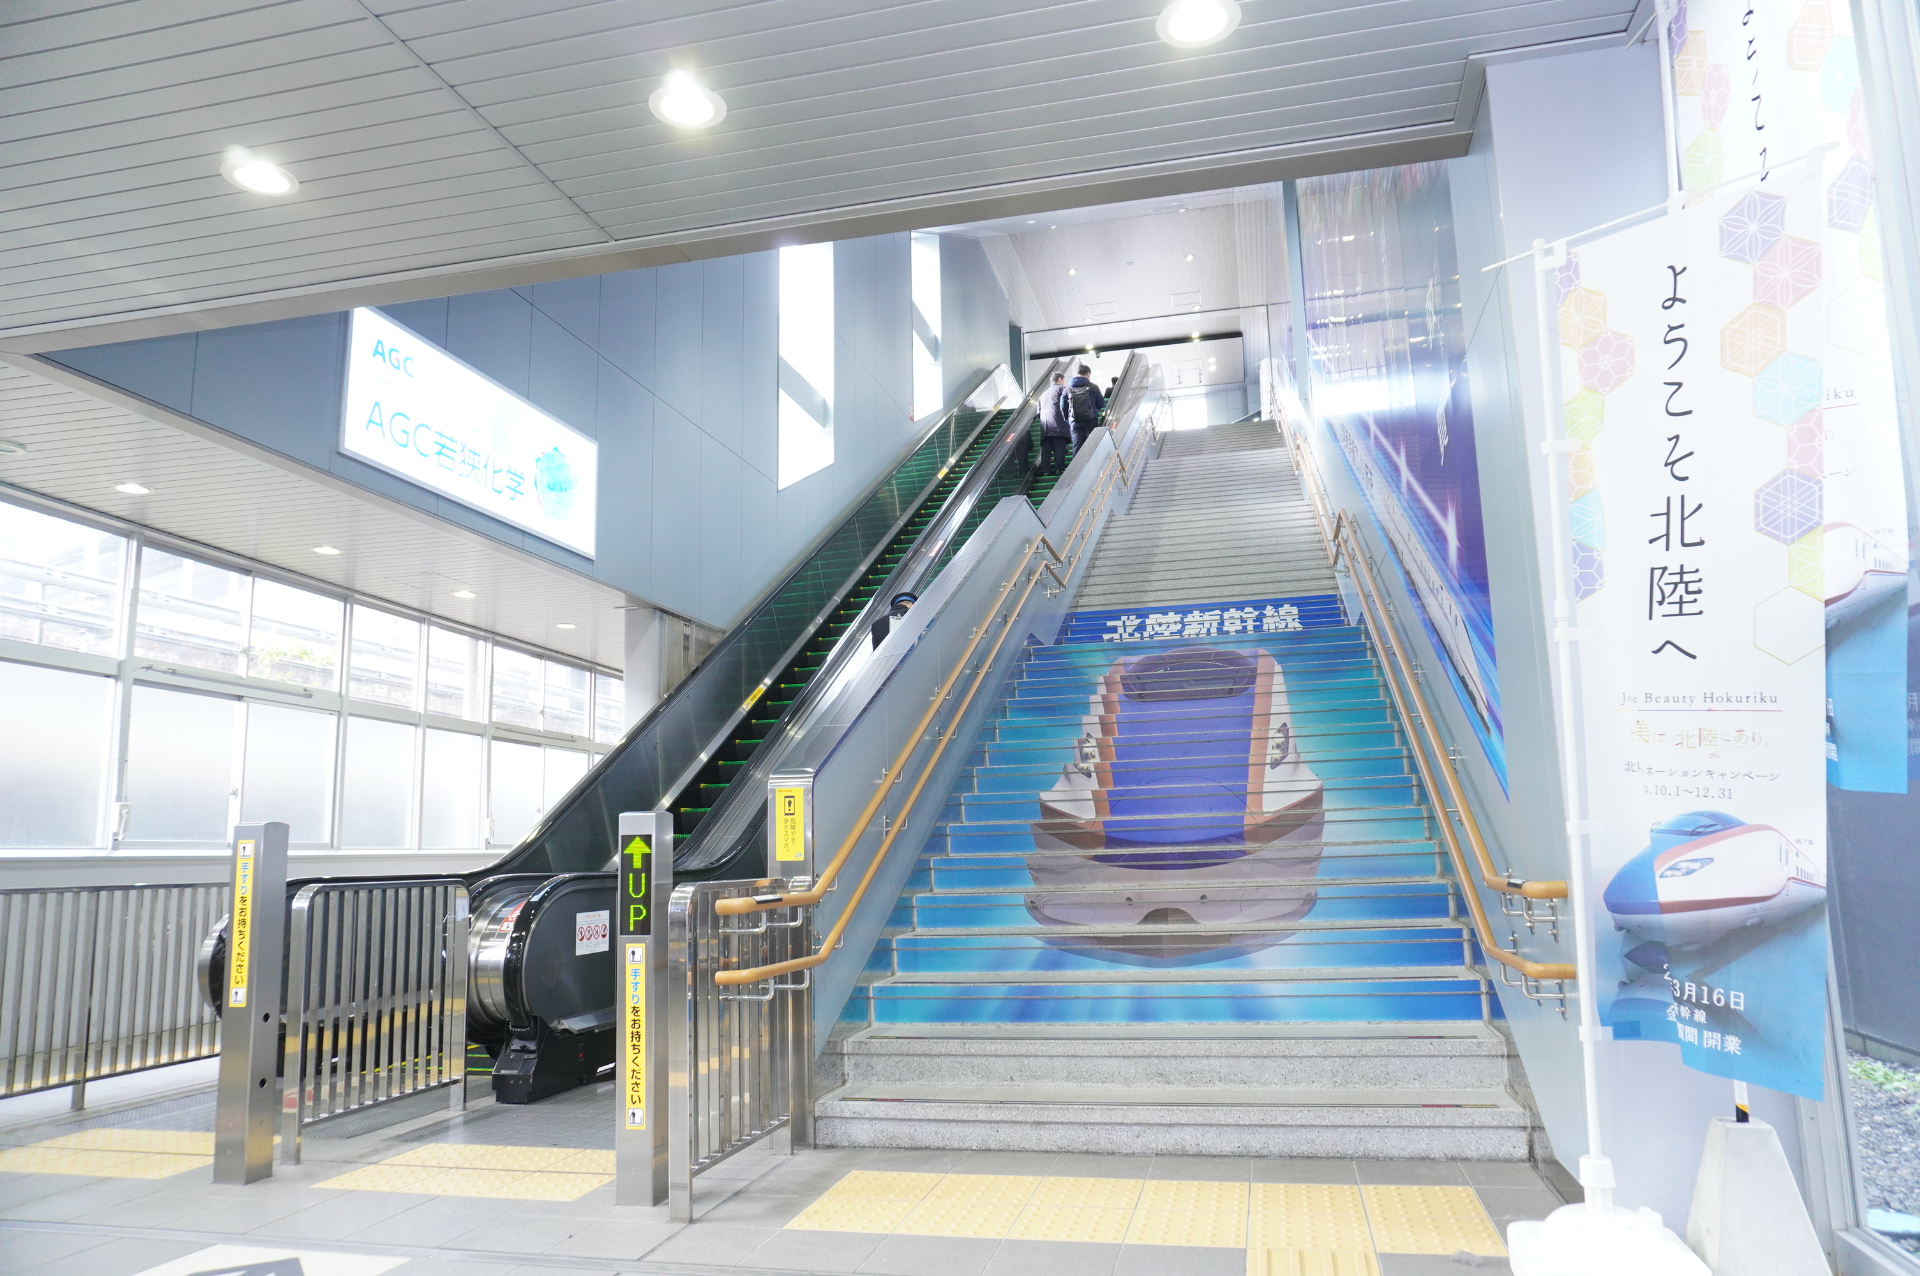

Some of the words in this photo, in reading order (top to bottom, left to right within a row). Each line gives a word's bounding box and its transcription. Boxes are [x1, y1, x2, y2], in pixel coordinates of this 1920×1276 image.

[371, 338, 414, 379] AGC
[365, 401, 526, 501] AGC若狭化学
[1647, 264, 1705, 661] ようこそ北陸へ
[1102, 603, 1303, 643] 北陸新幹線
[1644, 692, 1696, 707] Beauty
[1703, 692, 1778, 704] Hokuriku
[235, 862, 249, 986] 手すりをお持ちください
[629, 872, 647, 932] UP
[629, 967, 642, 1106] 手すりをお持ちください
